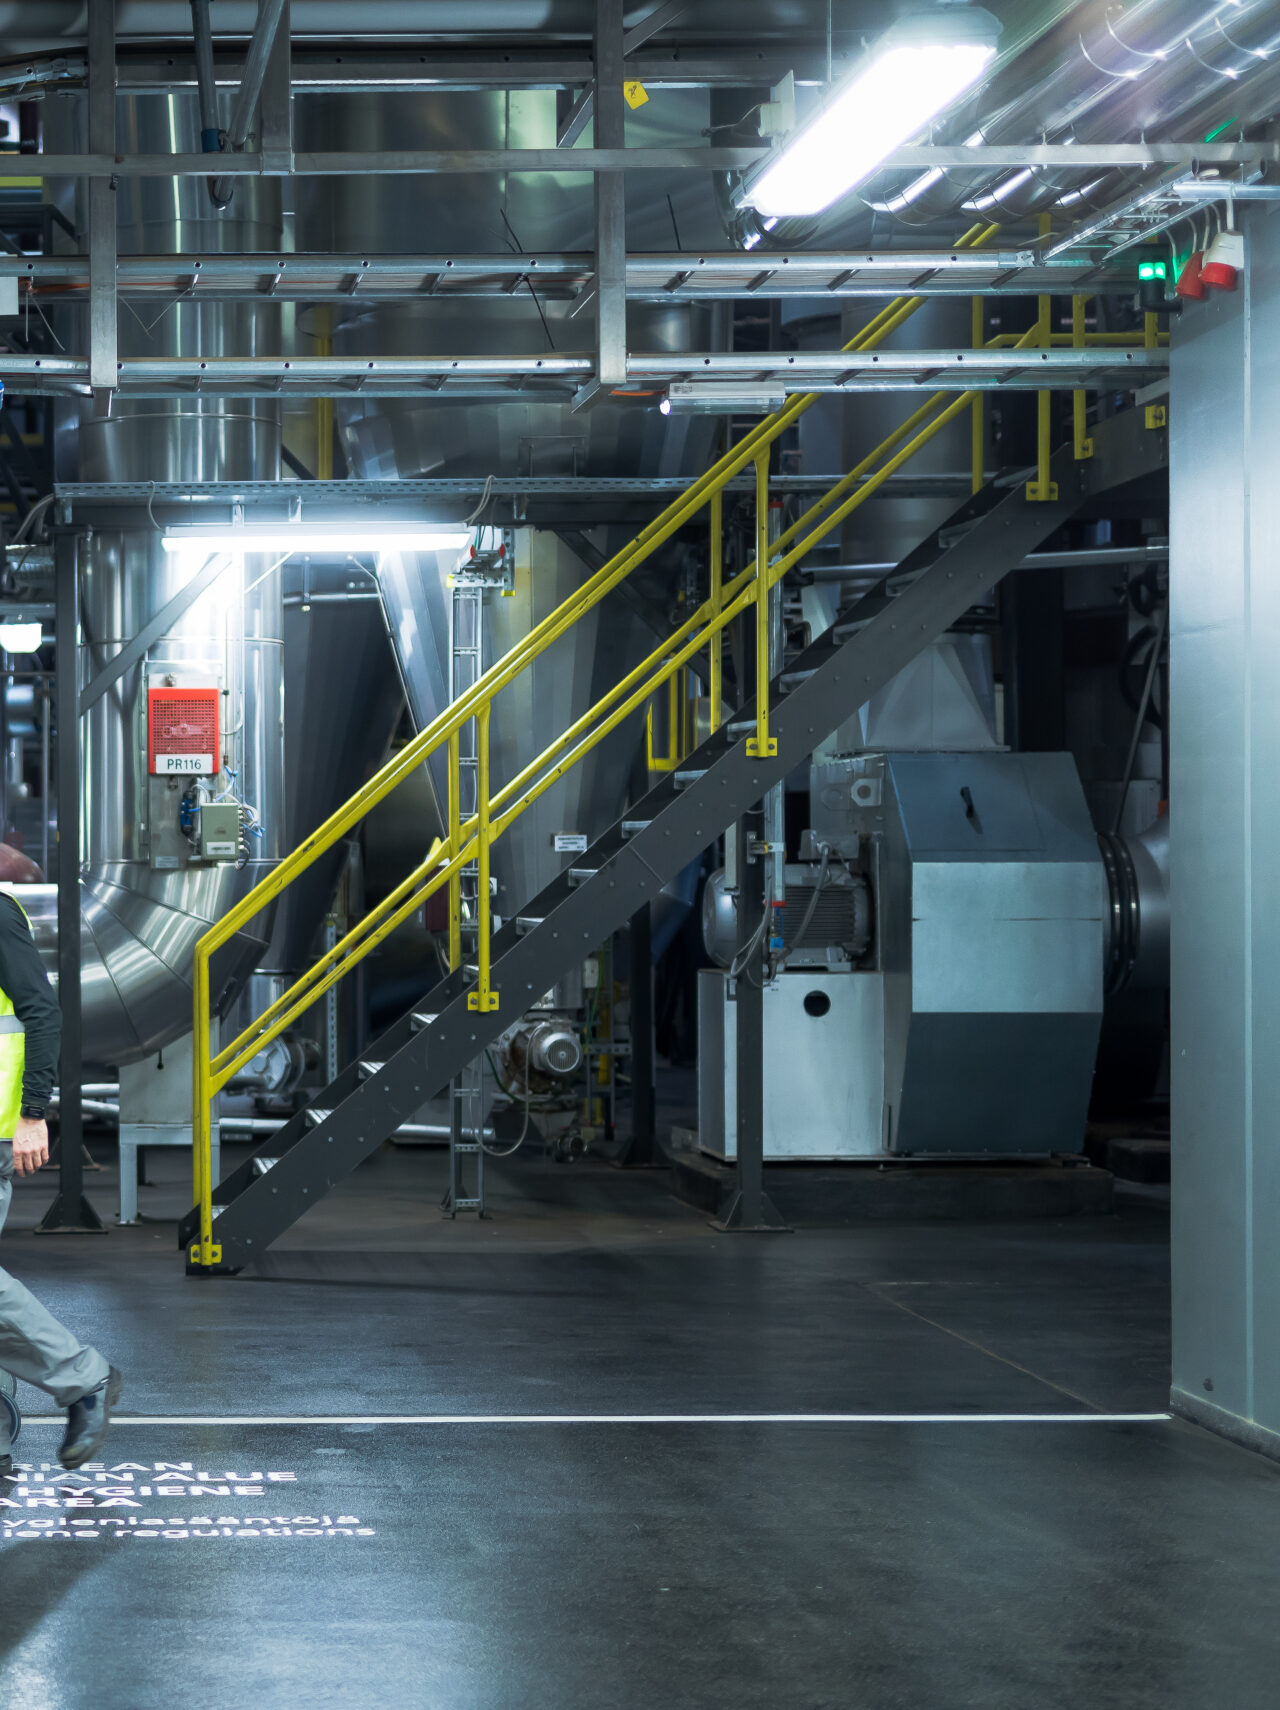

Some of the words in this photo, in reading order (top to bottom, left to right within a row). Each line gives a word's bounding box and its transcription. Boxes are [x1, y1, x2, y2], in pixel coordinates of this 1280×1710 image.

[167, 758, 202, 770] PR116
[152, 1471, 298, 1482] ALUE
[17, 1485, 266, 1497] HYGIENE
[114, 1526, 376, 1539] regulations
